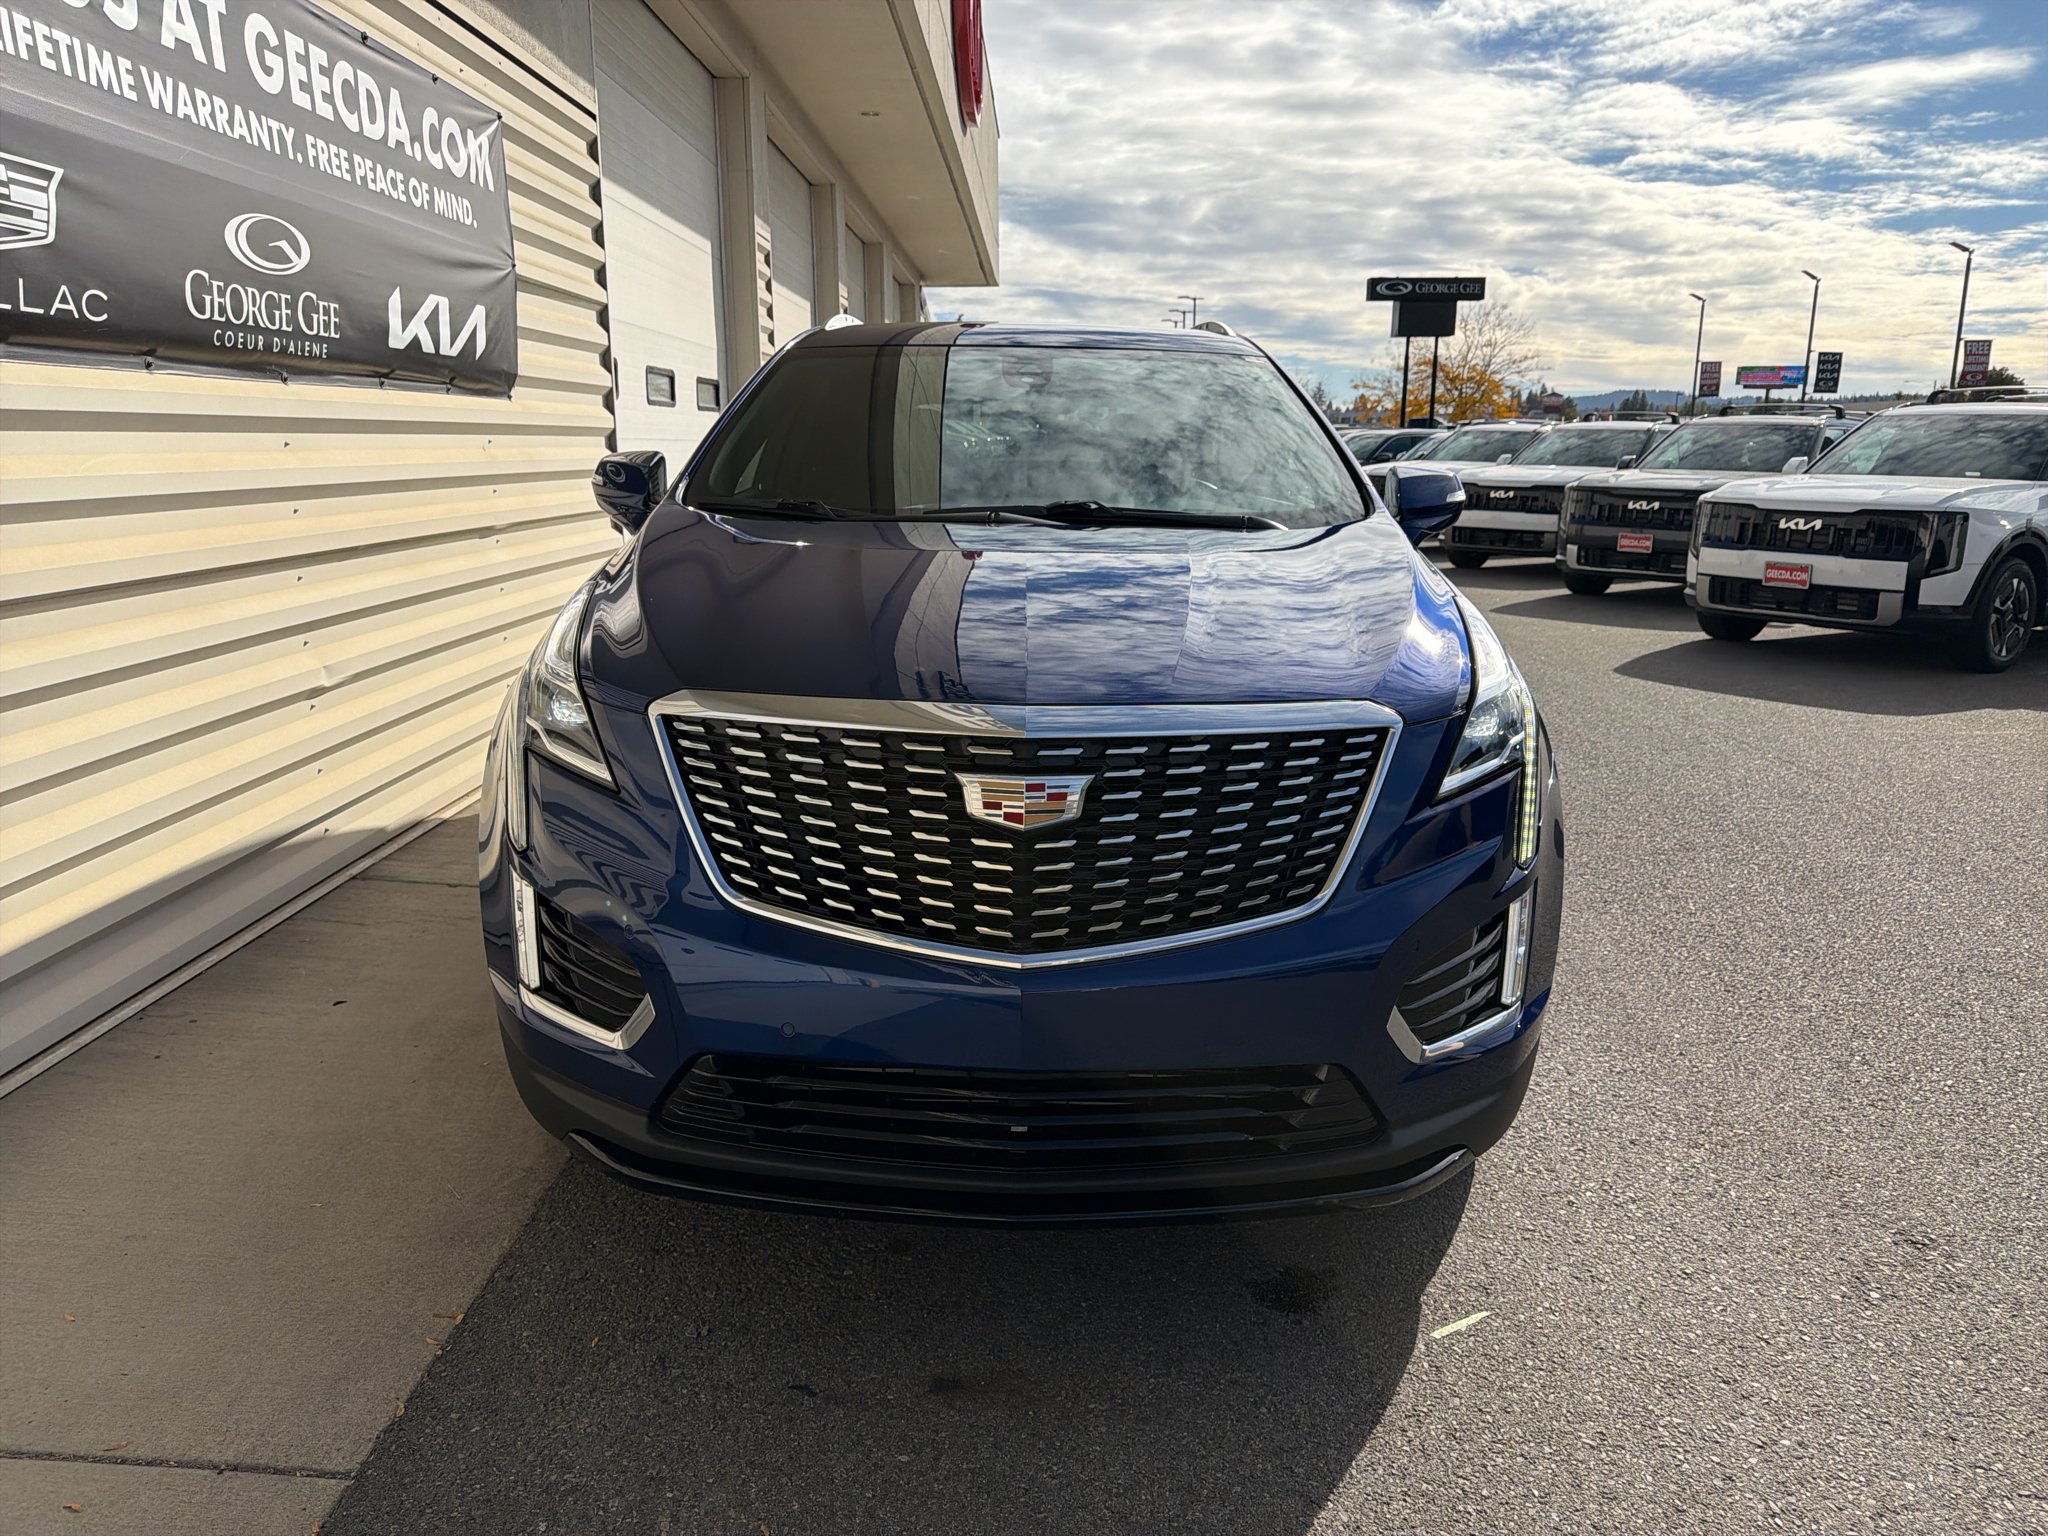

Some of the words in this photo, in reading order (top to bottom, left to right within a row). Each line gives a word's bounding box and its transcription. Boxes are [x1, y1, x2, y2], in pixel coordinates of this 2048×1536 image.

[160, 0, 227, 72] AT
[243, 12, 495, 192] GEECDA.COM
[0, 6, 138, 102] IFETIME
[139, 64, 303, 164] WARRANTY.
[305, 133, 352, 182] FREE
[353, 153, 407, 203] PEACE
[408, 177, 429, 210] OF
[433, 186, 478, 229] MIND.
[1415, 281, 1459, 294] GEORGE
[1460, 281, 1481, 294] GEE
[185, 269, 293, 332] GEORGE
[297, 291, 341, 339] GEE
[213, 329, 264, 351] COEUR
[272, 337, 328, 359] D'ALENE
[1966, 342, 1990, 354] FREE
[1766, 569, 1808, 580] GEECDA.COM
